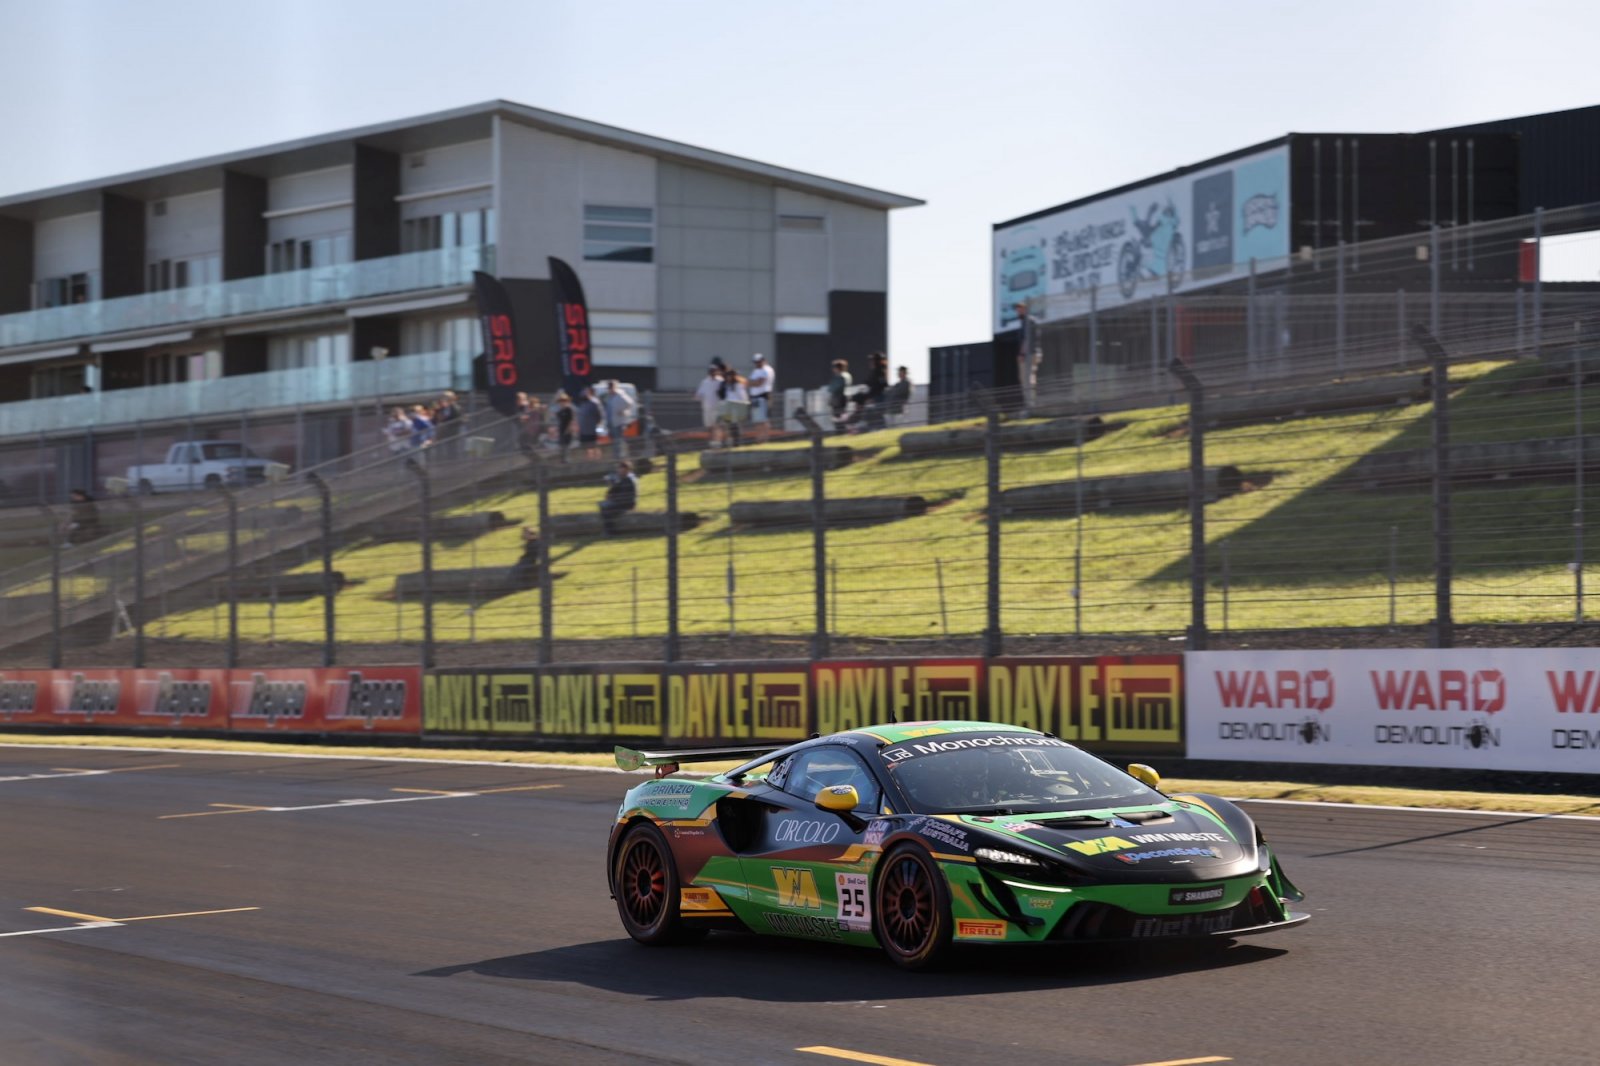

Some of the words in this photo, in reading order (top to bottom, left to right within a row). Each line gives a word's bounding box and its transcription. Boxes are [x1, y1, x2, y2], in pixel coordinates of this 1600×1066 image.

[489, 314, 517, 386] SRO
[564, 303, 591, 376] SRO
[423, 674, 489, 731] DAYLE
[541, 674, 611, 735] DAYLE
[668, 673, 749, 738] DAYLE
[817, 667, 909, 735] DAYLE
[989, 665, 1099, 740] DAYLE
[1214, 669, 1334, 711] WARD
[1369, 669, 1505, 714] WARD
[775, 819, 840, 843] CIRCOLO
[920, 826, 969, 851] AUSTRALIA
[1164, 832, 1229, 843] WASTE
[842, 888, 865, 917] 25
[959, 921, 1003, 936] PIRELLI
